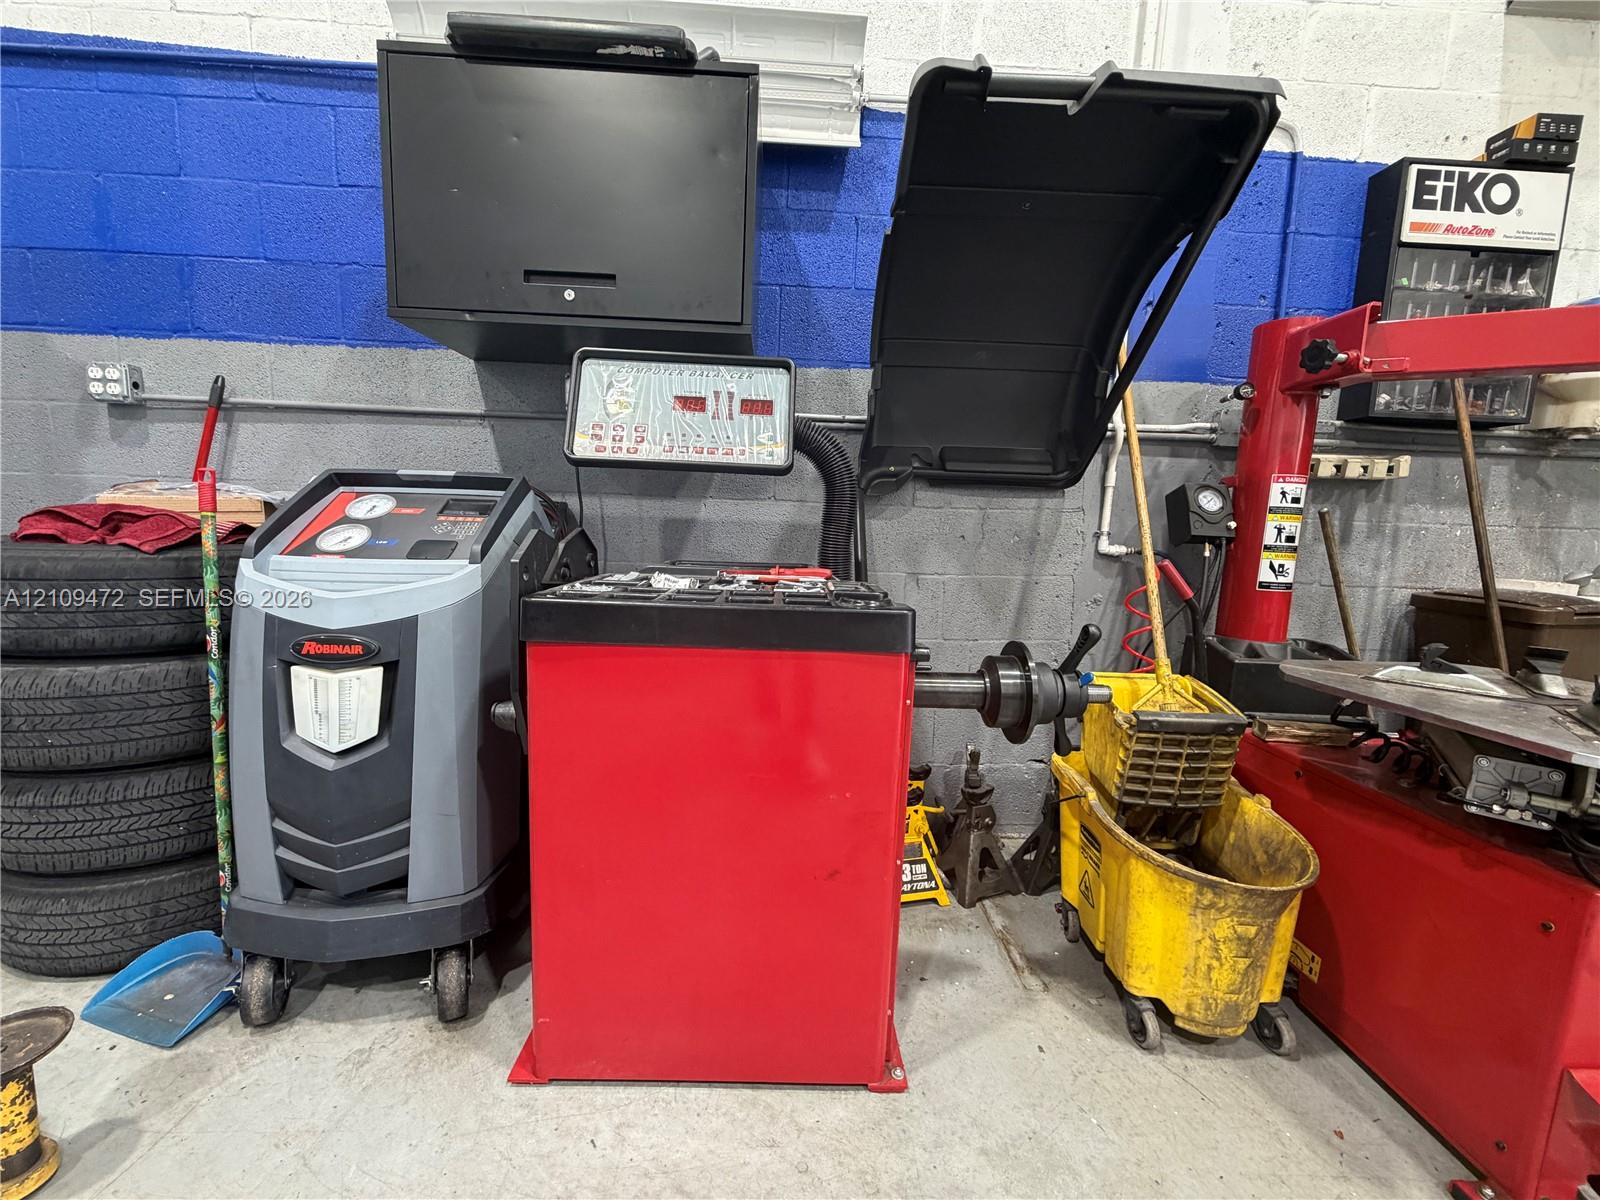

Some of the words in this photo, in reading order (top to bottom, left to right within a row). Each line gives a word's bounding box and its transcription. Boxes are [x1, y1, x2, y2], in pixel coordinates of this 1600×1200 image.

[1442, 224, 1496, 238] AutoZone
[617, 366, 688, 377] COMPUTER
[301, 641, 364, 655] ROBINAIR
[902, 863, 912, 881] 3
[912, 863, 927, 874] TON
[901, 880, 936, 891] AYTONA
